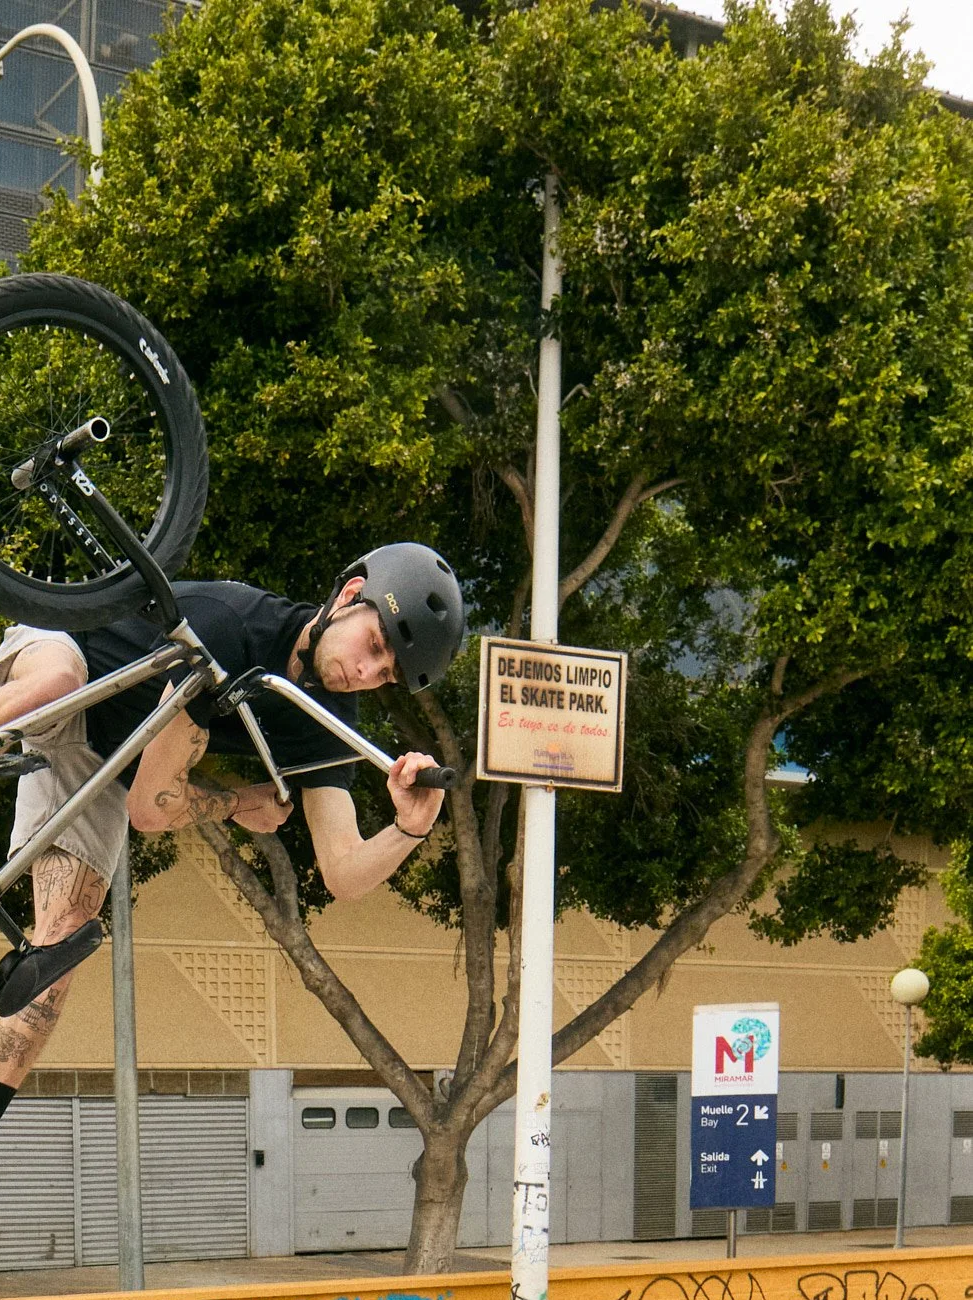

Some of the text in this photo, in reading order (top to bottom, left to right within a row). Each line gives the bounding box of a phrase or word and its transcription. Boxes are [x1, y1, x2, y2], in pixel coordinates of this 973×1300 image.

[40, 483, 102, 556] ODYSSEY
[498, 657, 612, 689] DEJEMOS LIMPIO
[500, 683, 608, 715] EL SKATE PARK.
[498, 711, 514, 728] Es
[714, 1075, 754, 1083] MIRAMAR
[700, 1117, 718, 1128] Bay
[701, 1104, 749, 1126] Muelle 2
[700, 1152, 730, 1162] Salida
[701, 1164, 717, 1174] Exit
